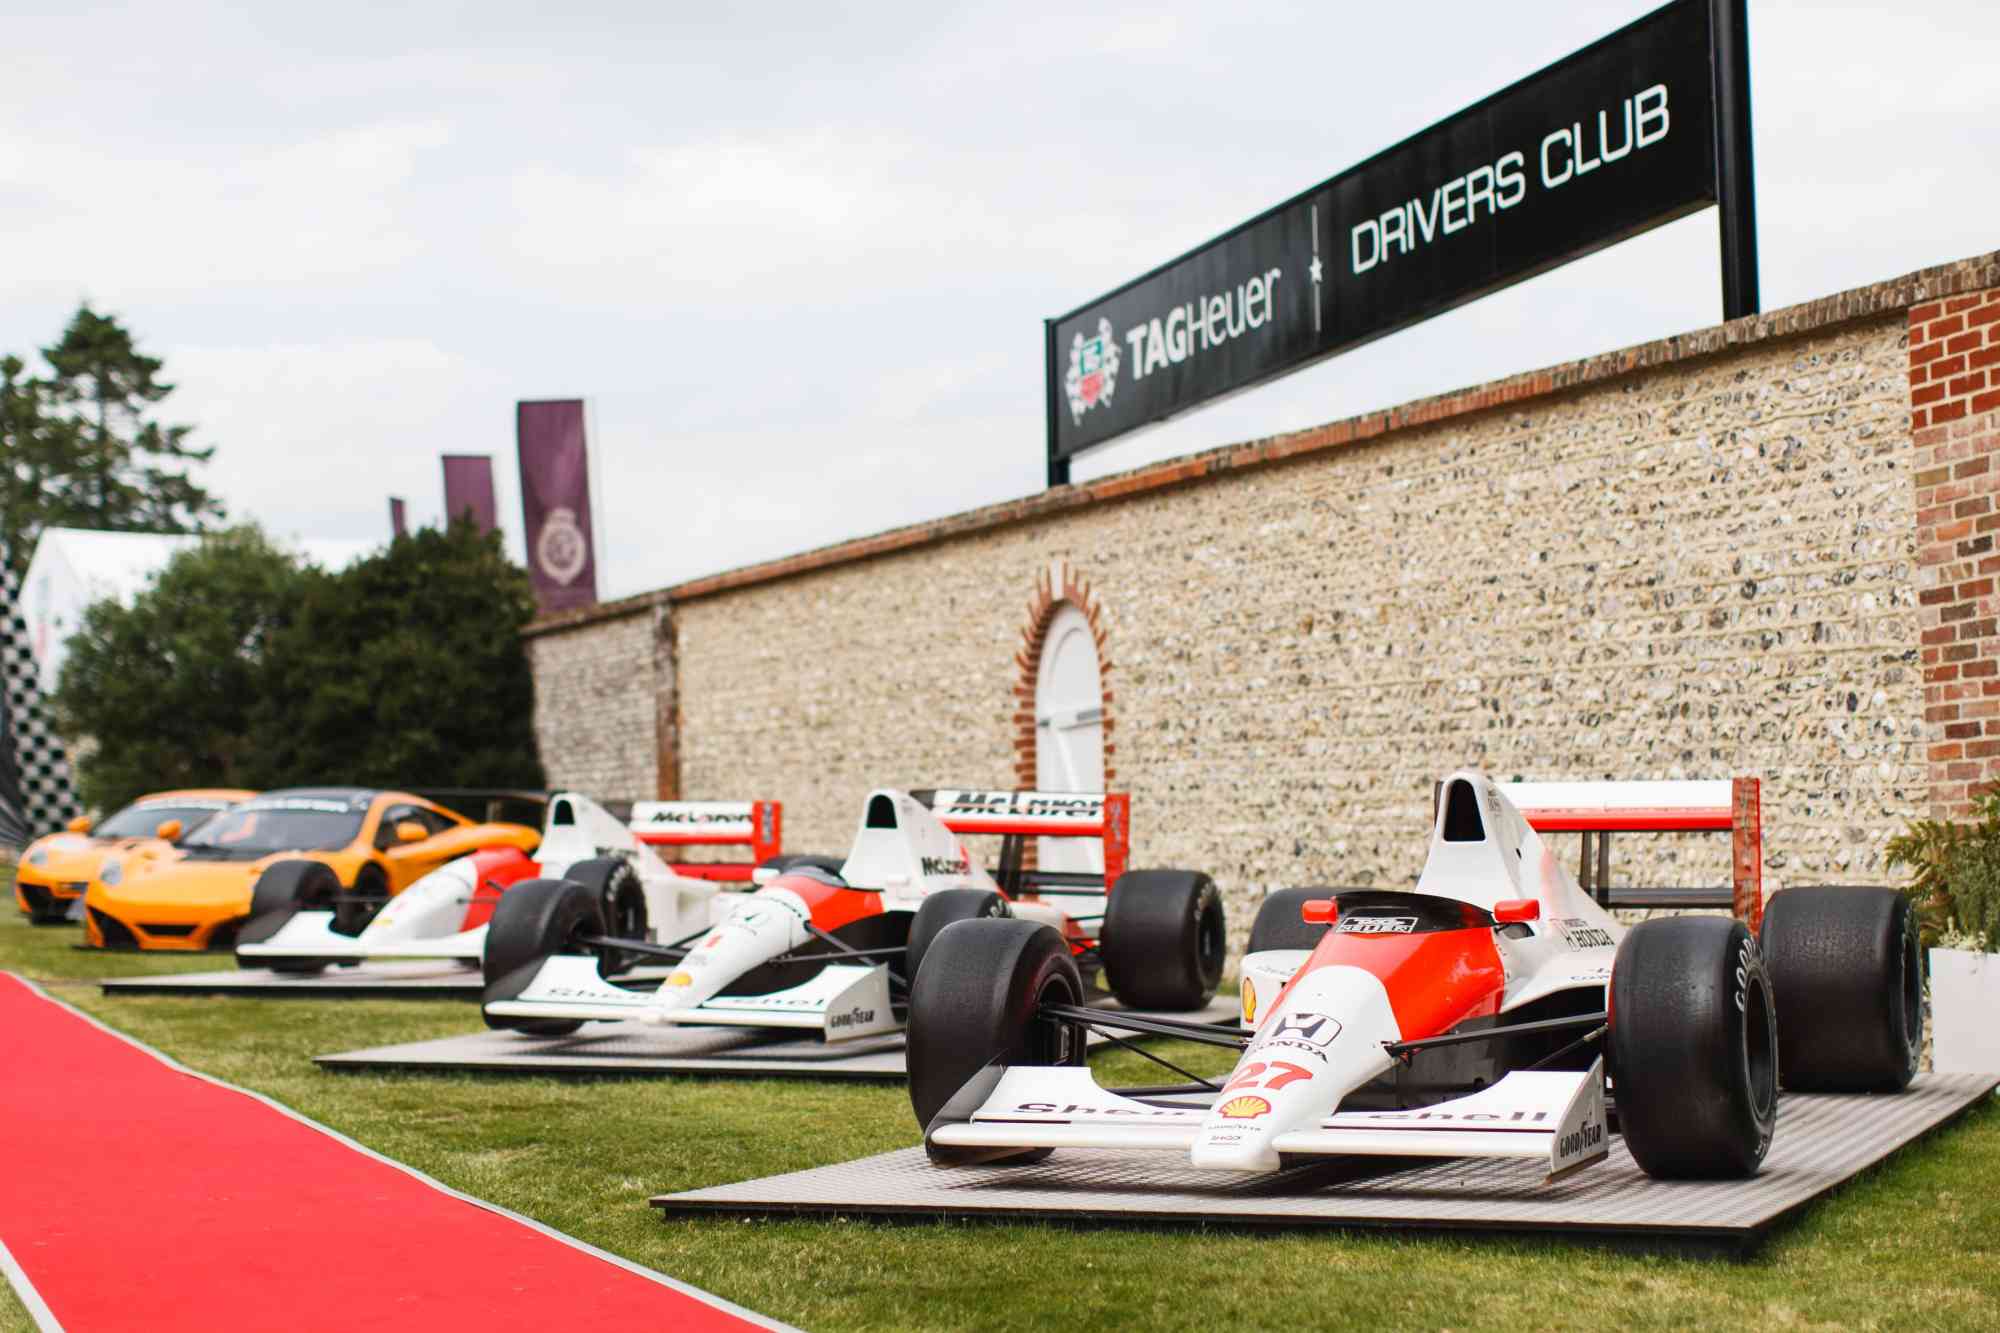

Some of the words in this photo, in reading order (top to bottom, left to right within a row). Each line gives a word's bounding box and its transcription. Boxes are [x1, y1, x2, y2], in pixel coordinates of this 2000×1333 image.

[1352, 151, 1525, 276] DRIVERS
[1541, 84, 1670, 189] CLUB
[652, 811, 753, 823] McLaren
[949, 793, 1104, 816] McLaren
[1220, 1060, 1313, 1096] 27
[1560, 1120, 1601, 1158] GOODYEAR
